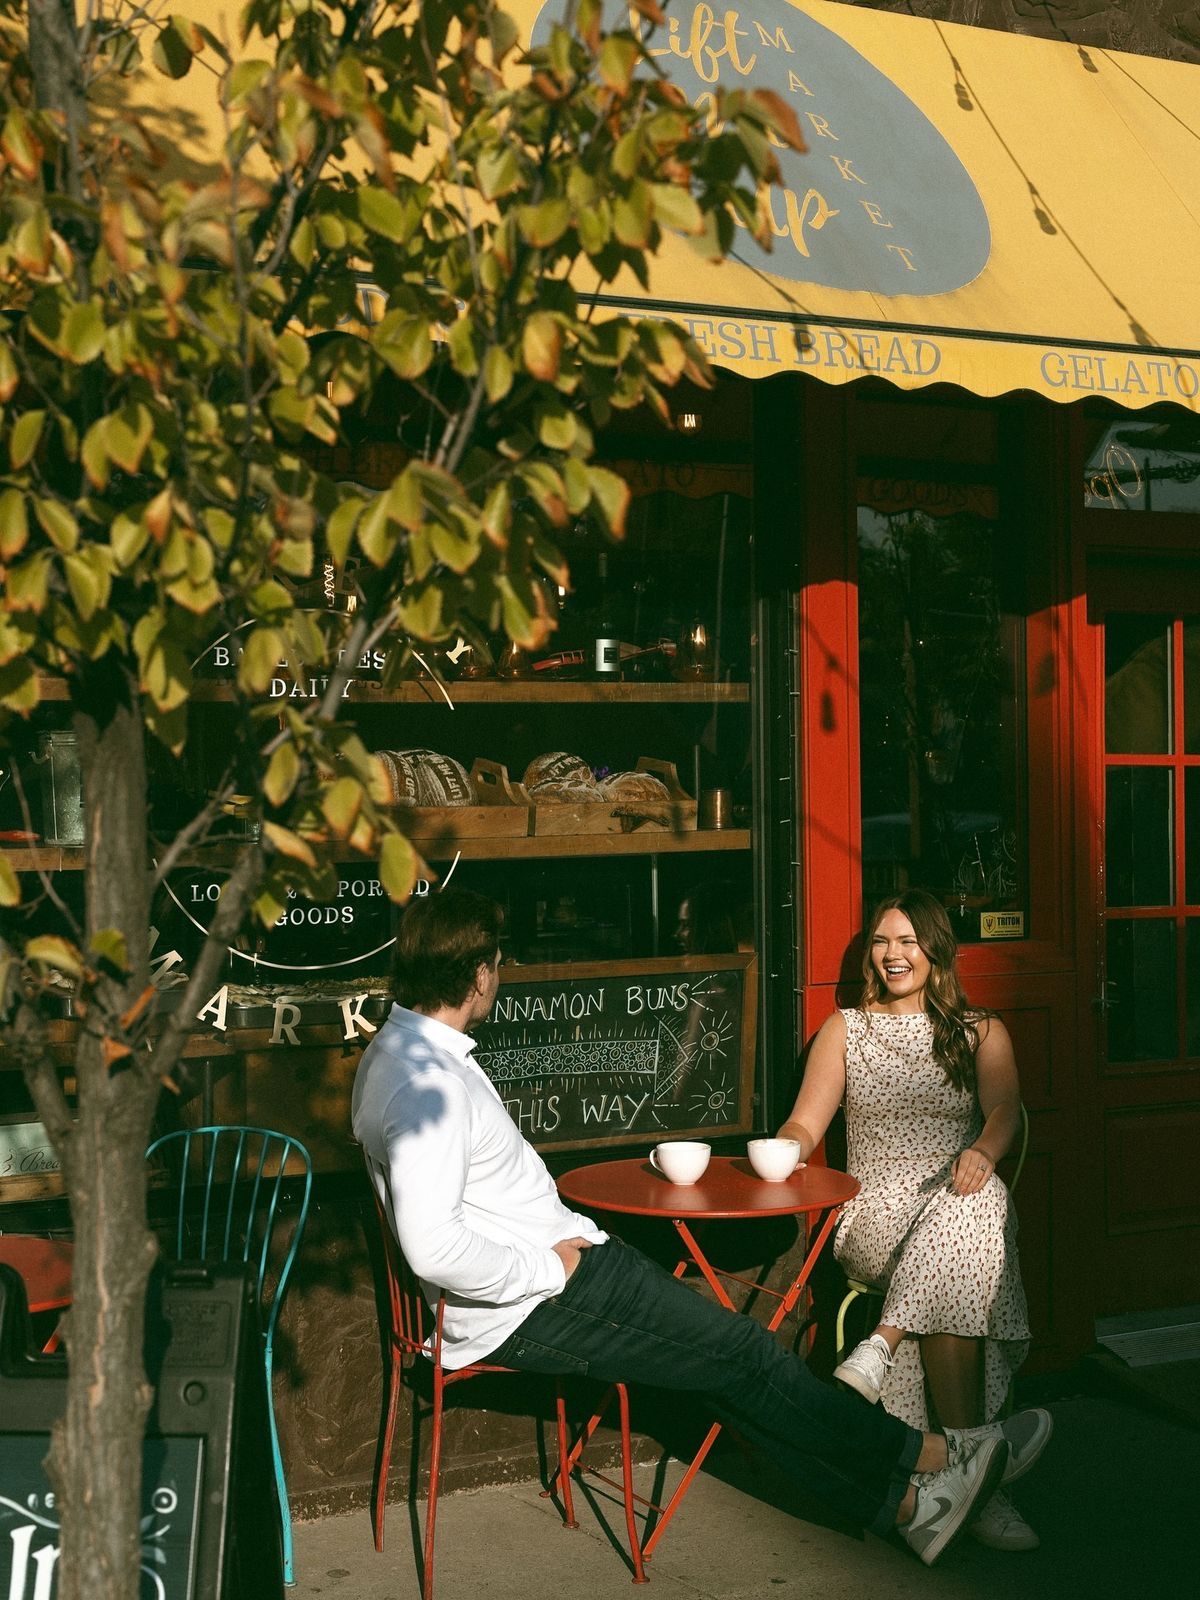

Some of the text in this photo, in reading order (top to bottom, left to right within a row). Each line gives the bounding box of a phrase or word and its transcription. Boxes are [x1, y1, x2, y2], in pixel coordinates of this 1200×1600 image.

[752, 20, 917, 271] MARKET
[617, 312, 942, 377] ESH BREAD
[1040, 352, 1199, 398] GELATO
[437, 763, 454, 776] ME
[548, 762, 565, 777] IFT
[446, 776, 463, 799] LIFT
[305, 878, 430, 900] PORD
[275, 906, 354, 926] GOODS
[997, 916, 1021, 926] TRITON
[485, 982, 690, 1023] NNAMON BUNS
[502, 1092, 650, 1134] THIS WAY
[20, 1146, 61, 1172] Brea
